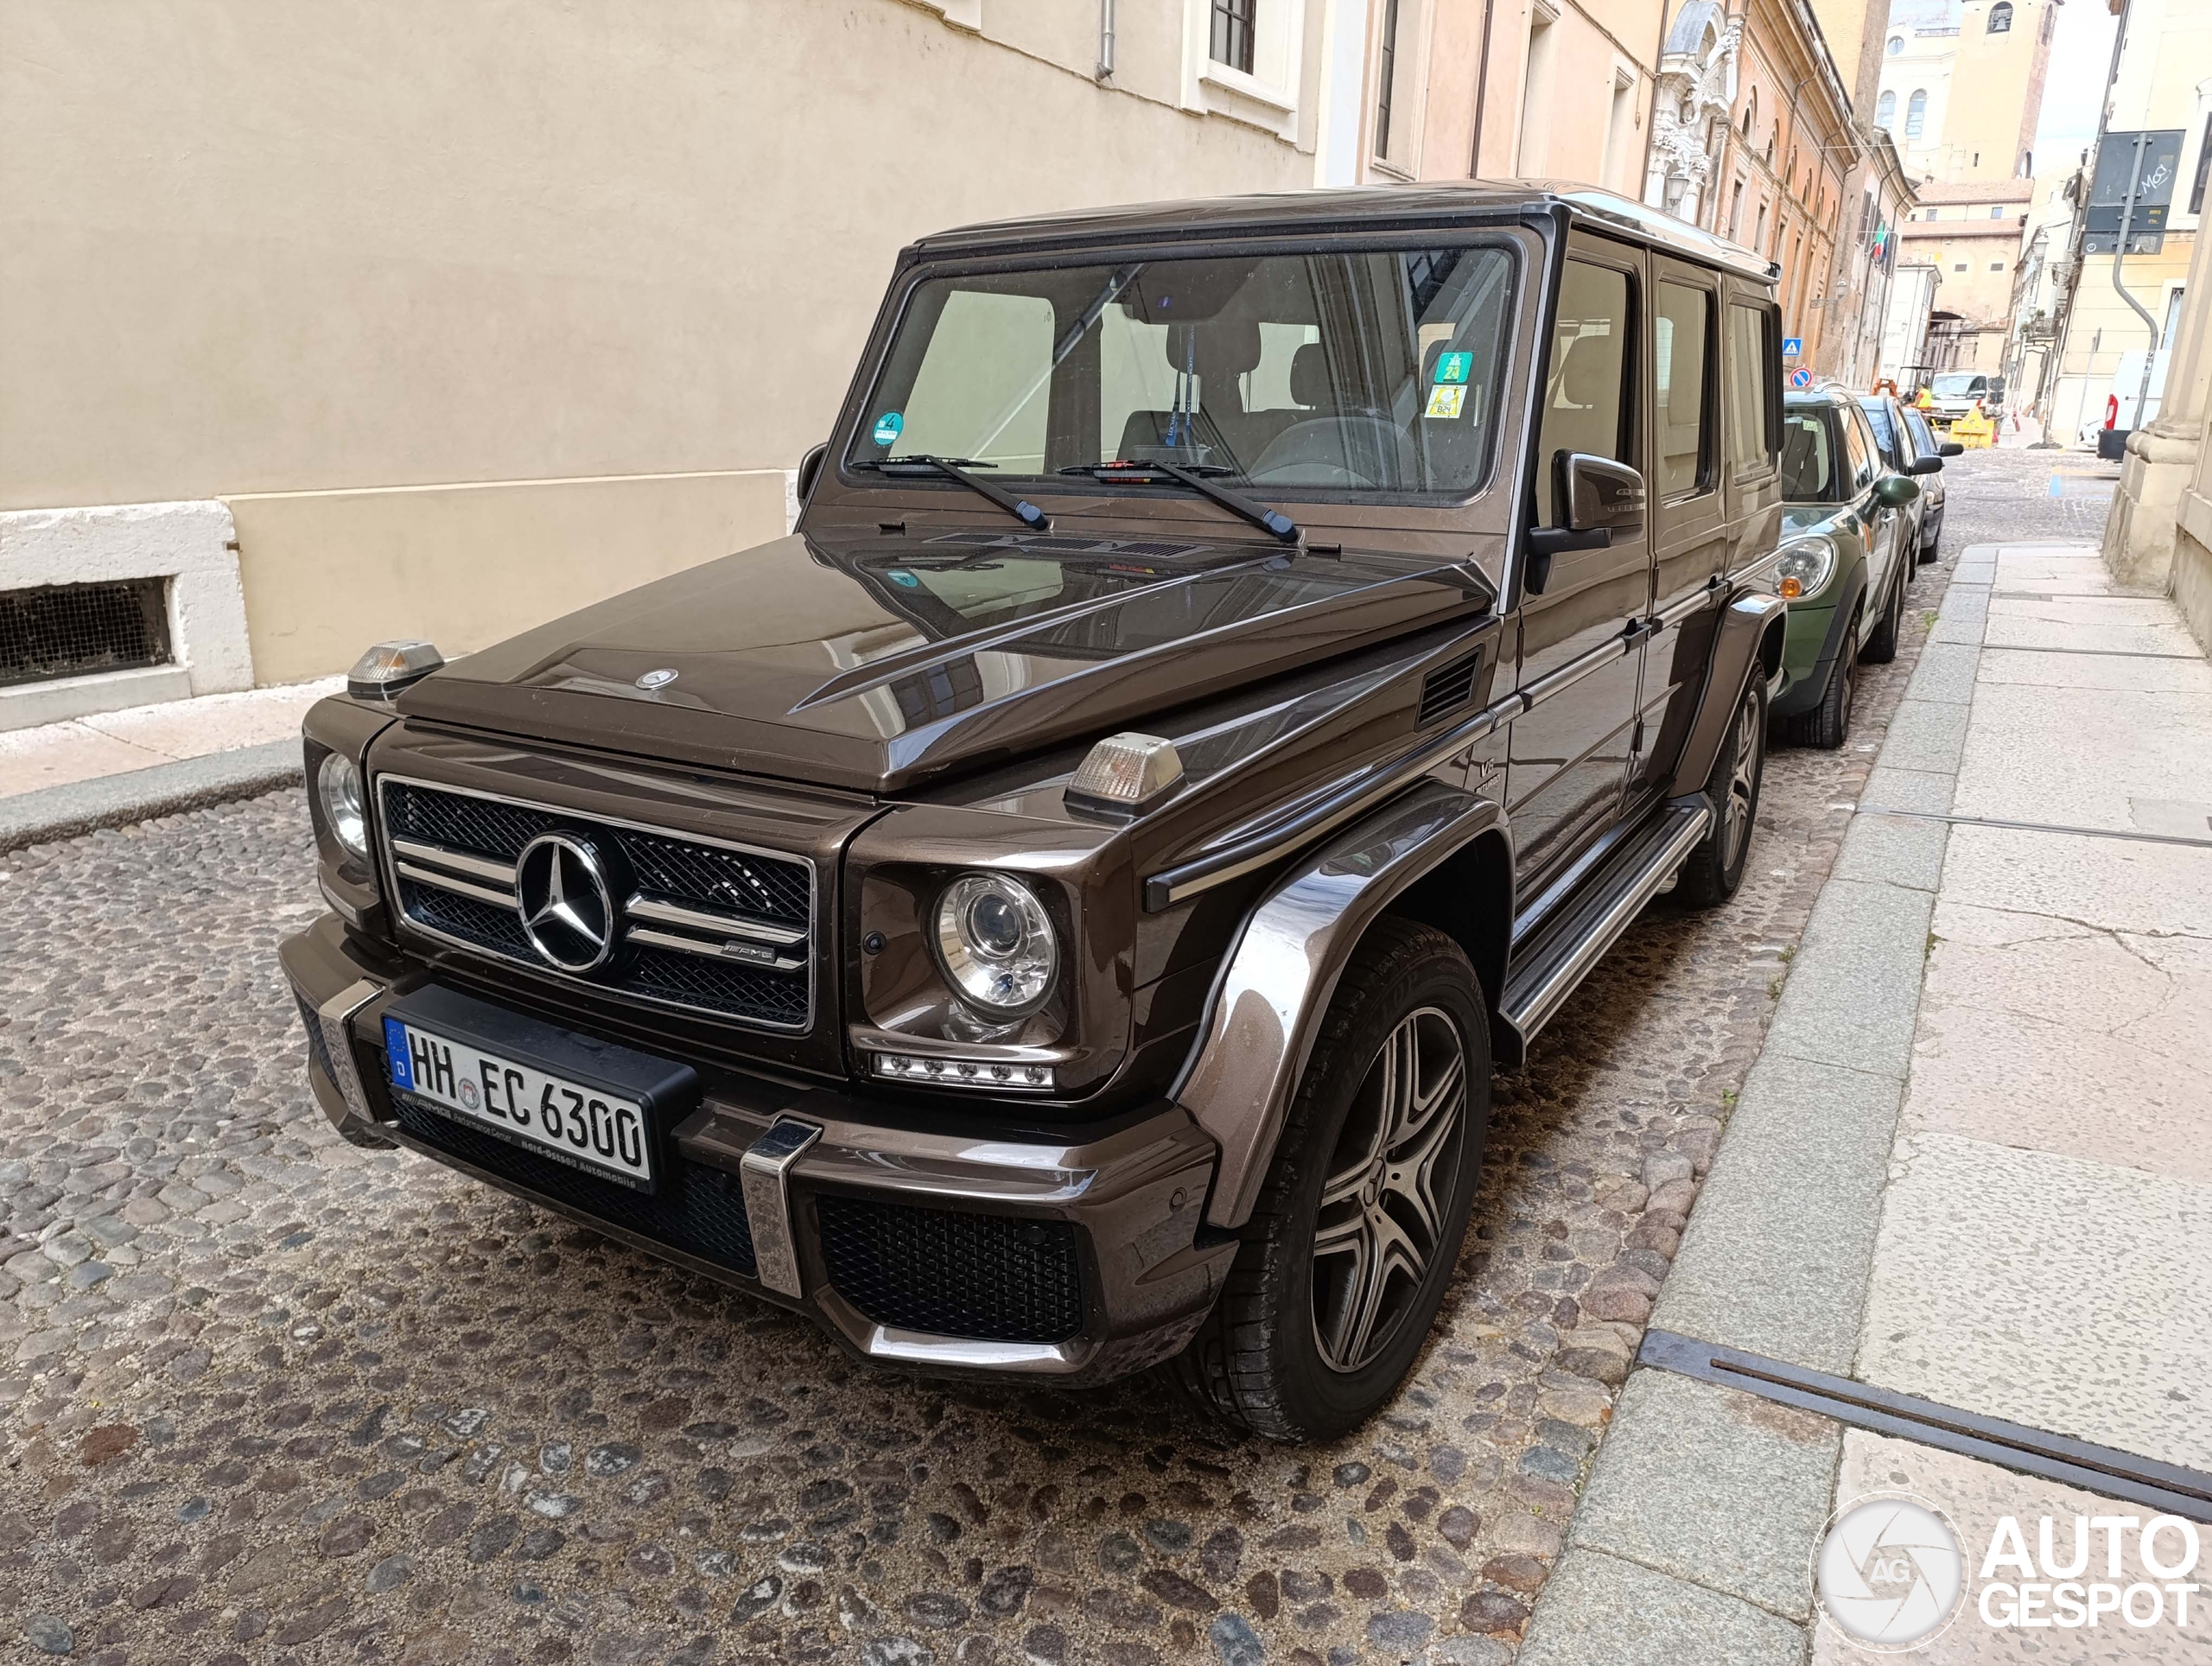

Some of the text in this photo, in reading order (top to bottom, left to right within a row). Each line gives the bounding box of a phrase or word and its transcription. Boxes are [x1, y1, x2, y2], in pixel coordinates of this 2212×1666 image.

[886, 415, 895, 429] 4
[397, 1060, 405, 1077] D
[409, 1032, 456, 1099] HH
[479, 1059, 531, 1126] EC
[541, 1083, 642, 1167] 6300
[416, 1099, 451, 1119] AMG
[454, 1113, 491, 1135] Performance
[580, 1161, 637, 1189] Automobile
